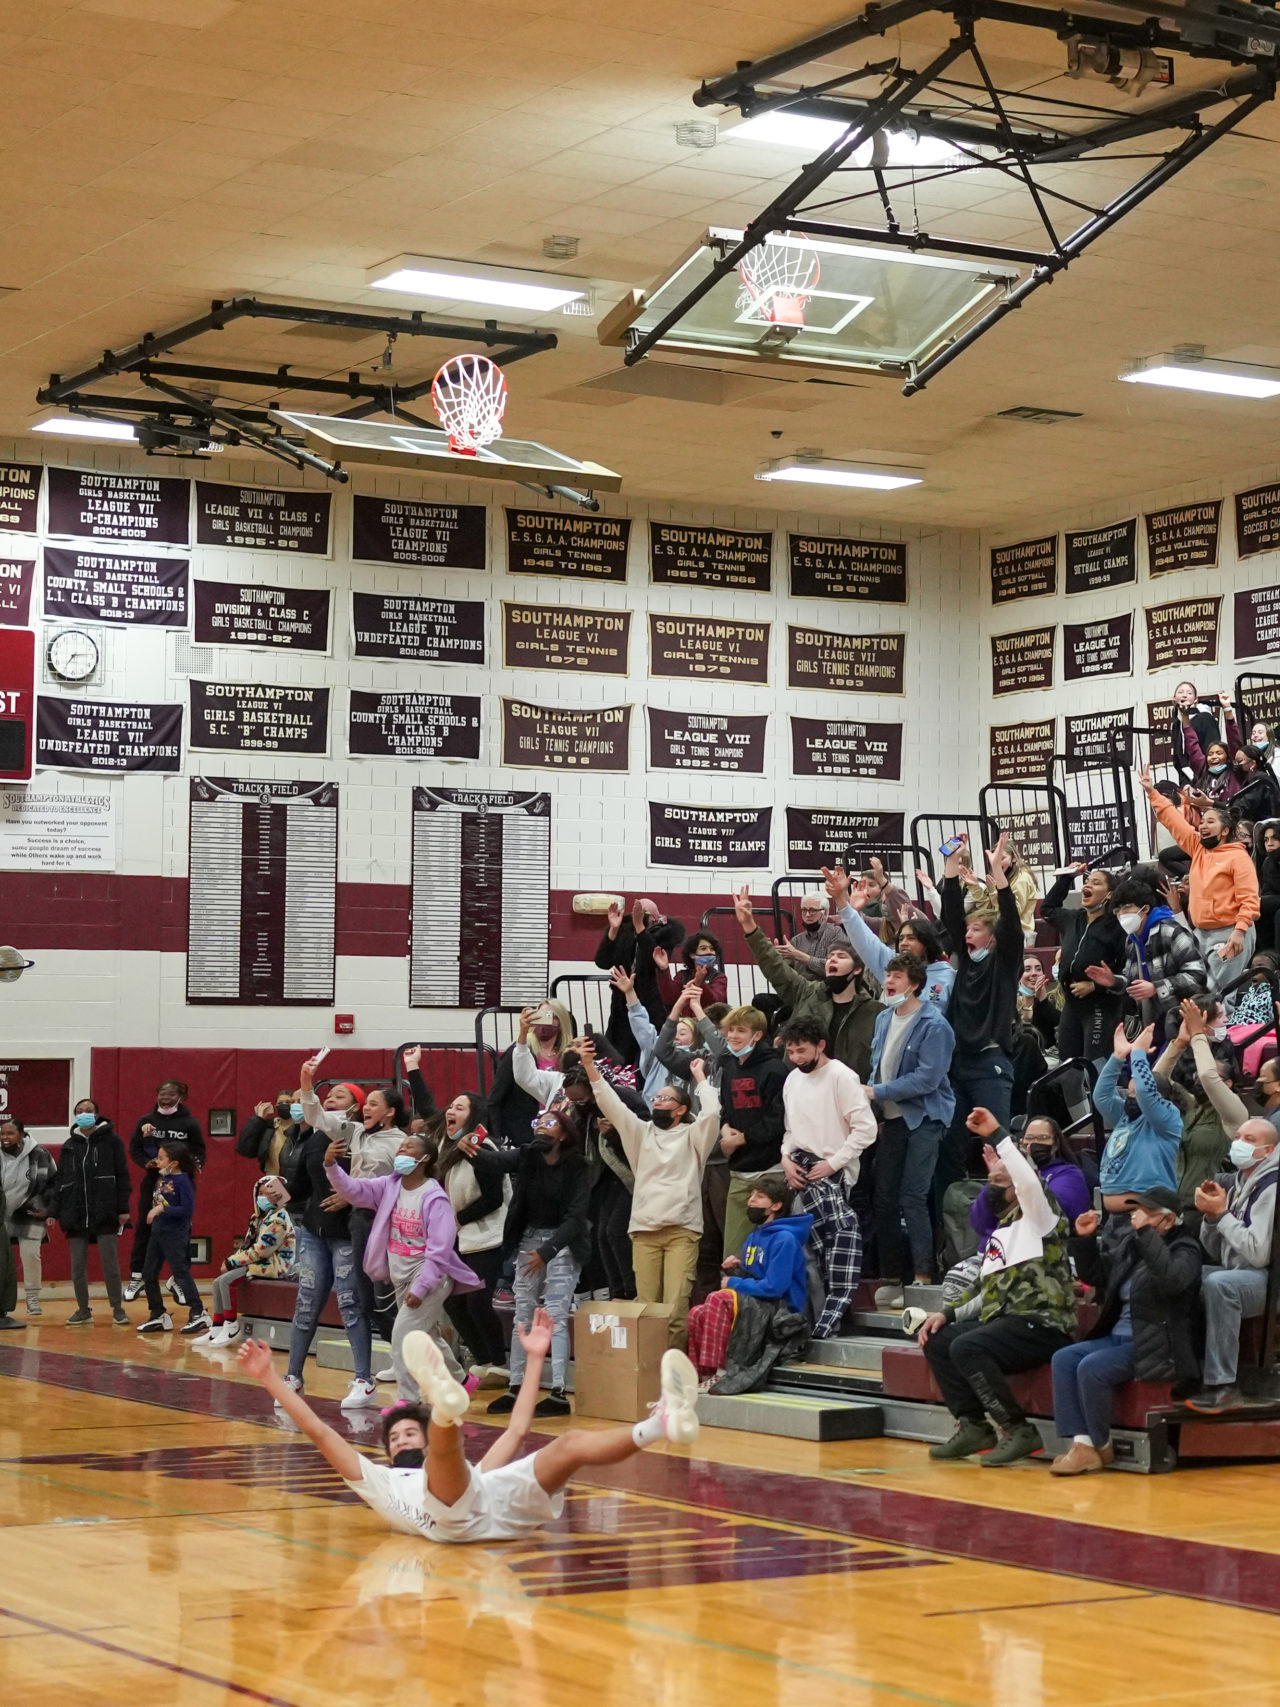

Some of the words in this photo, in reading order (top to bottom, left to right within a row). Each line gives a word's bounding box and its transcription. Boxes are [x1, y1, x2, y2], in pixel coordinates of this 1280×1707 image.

[80, 475, 160, 491] SOUTHAMPTON
[79, 488, 102, 498] GIRLS
[108, 491, 161, 501] BASKETBALL
[240, 490, 285, 507] SOUTHAMPTON
[88, 499, 130, 512] LEAGUE
[139, 503, 154, 515] VII
[206, 504, 240, 517] LEAGUE
[248, 508, 263, 519] VII
[280, 511, 307, 522] CLASS
[315, 513, 320, 523] C
[384, 503, 458, 520] SOUTHAMPTON
[80, 512, 158, 528] CO-CHAMPIONS
[381, 516, 403, 525] GIRLS
[410, 519, 459, 529] BASKETBALL
[1152, 506, 1214, 529] SOUTHAMPTON
[212, 520, 229, 530] GIRLS
[235, 522, 274, 535] BASKETBALL
[280, 526, 313, 537] CHAMPIONS
[517, 515, 621, 536] SOUTHAMPTON
[1244, 521, 1268, 535] SOCCER
[390, 527, 427, 540] LEAGUE
[436, 530, 449, 541] VII
[661, 529, 762, 550] SOUTHAMPTON
[1073, 527, 1127, 548] SOUTHAMPTON
[391, 539, 448, 553] CHAMPIONS
[571, 536, 625, 550] CHAMPIONS
[799, 541, 896, 560] SOUTHAMPTON
[393, 552, 445, 563] 2005-2006
[533, 548, 561, 557] GIRLS
[567, 550, 602, 561] TENNIS
[716, 550, 768, 563] CHAMPIONS
[77, 556, 157, 573] SOUTHAMPTON
[559, 562, 577, 570] TO
[677, 560, 704, 568] GIRLS
[712, 562, 745, 572] TENNIS
[851, 562, 902, 575] CHAMPIONS
[1104, 556, 1128, 569] CHAMPS
[74, 570, 98, 579] GIRLS
[106, 572, 159, 583] BASKETBALL
[703, 572, 721, 581] TO
[815, 572, 842, 580] GIRLS
[847, 574, 880, 583] TENNIS
[93, 582, 126, 595] SMALL
[132, 585, 173, 598] SCHOOLS
[240, 588, 285, 605] SOUTHAMPTON
[71, 593, 105, 608] CLASS
[112, 597, 118, 607] B
[125, 598, 184, 612] CHAMPIONS
[384, 599, 455, 614] SOUTHAMPTON
[215, 603, 251, 615] DIVISION
[270, 607, 297, 619] CLASS
[303, 610, 309, 620] C
[381, 612, 402, 620] GIRLS
[409, 613, 457, 624] BASKETBALL
[1152, 603, 1214, 624] SOUTHAMPTON
[212, 616, 229, 628] GIRLS
[234, 617, 273, 631] BASKETBALL
[278, 621, 312, 634] CHAMPIONS
[511, 610, 624, 631] SOUTHAMPTON
[1255, 612, 1279, 628] LEAGUE
[390, 622, 427, 634] LEAGUE
[435, 625, 449, 636] VII
[536, 628, 580, 641] LEAGUE
[587, 633, 598, 643] VI
[656, 621, 764, 641] SOUTHAMPTON
[357, 631, 420, 646] UNDEFEATED
[427, 637, 482, 650] CHAMPIONS
[680, 639, 722, 651] LEAGUE
[729, 643, 740, 653] VI
[795, 632, 898, 651] SOUTHAMPTON
[996, 632, 1050, 652] SOUTHAMPTON
[1074, 639, 1106, 652] LEAGUE
[516, 641, 559, 651] GIRLS
[566, 645, 618, 656] TENNIS
[818, 649, 854, 661] LEAGUE
[861, 652, 876, 662] VII
[664, 651, 703, 660] GIRLS
[710, 654, 759, 665] TENNIS
[797, 660, 818, 673] GIRLS
[822, 662, 849, 676] TENNIS
[854, 665, 896, 678] CHAMPIONS
[206, 684, 313, 702] SOUTHAMPTON
[236, 700, 268, 710] LEAGUE
[273, 703, 282, 711] VI
[380, 695, 451, 707] SOUTHAMPTON
[70, 703, 151, 720] SOUTHAMPTON
[204, 710, 235, 722] GIRLS
[242, 711, 313, 726] BASKETBALL
[405, 706, 453, 716] BASKETBALL
[67, 718, 91, 727] GIRLS
[99, 720, 153, 730] BASKETBALL
[351, 712, 387, 724] COUNTY
[392, 714, 423, 725] SMALL
[427, 716, 466, 726] SCHOOLS
[688, 716, 728, 731] SOUTHAMPTON
[1070, 713, 1129, 733] SOUTHAMPTON
[76, 728, 119, 742] LEAGUE
[128, 732, 144, 743] VII
[263, 726, 308, 739] CHAMPS
[405, 725, 435, 736] CLASS
[442, 726, 450, 736] B
[537, 724, 578, 736] LEAGUE
[585, 727, 599, 737] VII
[664, 729, 718, 743] LEAGUE
[726, 734, 751, 744] VIII
[827, 723, 866, 737] SOUTHAMPTON
[996, 724, 1050, 742] SOUTHAMPTON
[1076, 731, 1108, 744] LEAGUE
[39, 738, 111, 755] UNDEFEATED
[118, 745, 178, 757] CHAMPIONS
[387, 735, 443, 747] CHAMPIONS
[519, 736, 539, 750] GIRLS
[545, 738, 569, 752] TENNIS
[575, 740, 614, 754] CHAMPIONS
[806, 738, 857, 750] LEAGUE
[865, 741, 888, 752] VIII
[670, 744, 685, 755] GIRLS
[691, 746, 709, 756] TENNIS
[715, 747, 743, 758] CHAMPIONS
[812, 752, 826, 762] GIRLS
[832, 752, 849, 763] TENNIS
[856, 754, 884, 765] CHAMPIONS
[664, 808, 758, 823] SOUTHAMPTON
[811, 814, 880, 827] SOUTHAMPTON
[688, 827, 717, 835] LEAGUE
[826, 831, 853, 839] LEAGUE
[655, 836, 681, 848] GIRLS
[688, 839, 723, 851] TENNIS
[729, 841, 766, 851] CHAMPS
[789, 840, 812, 851] GIRLS
